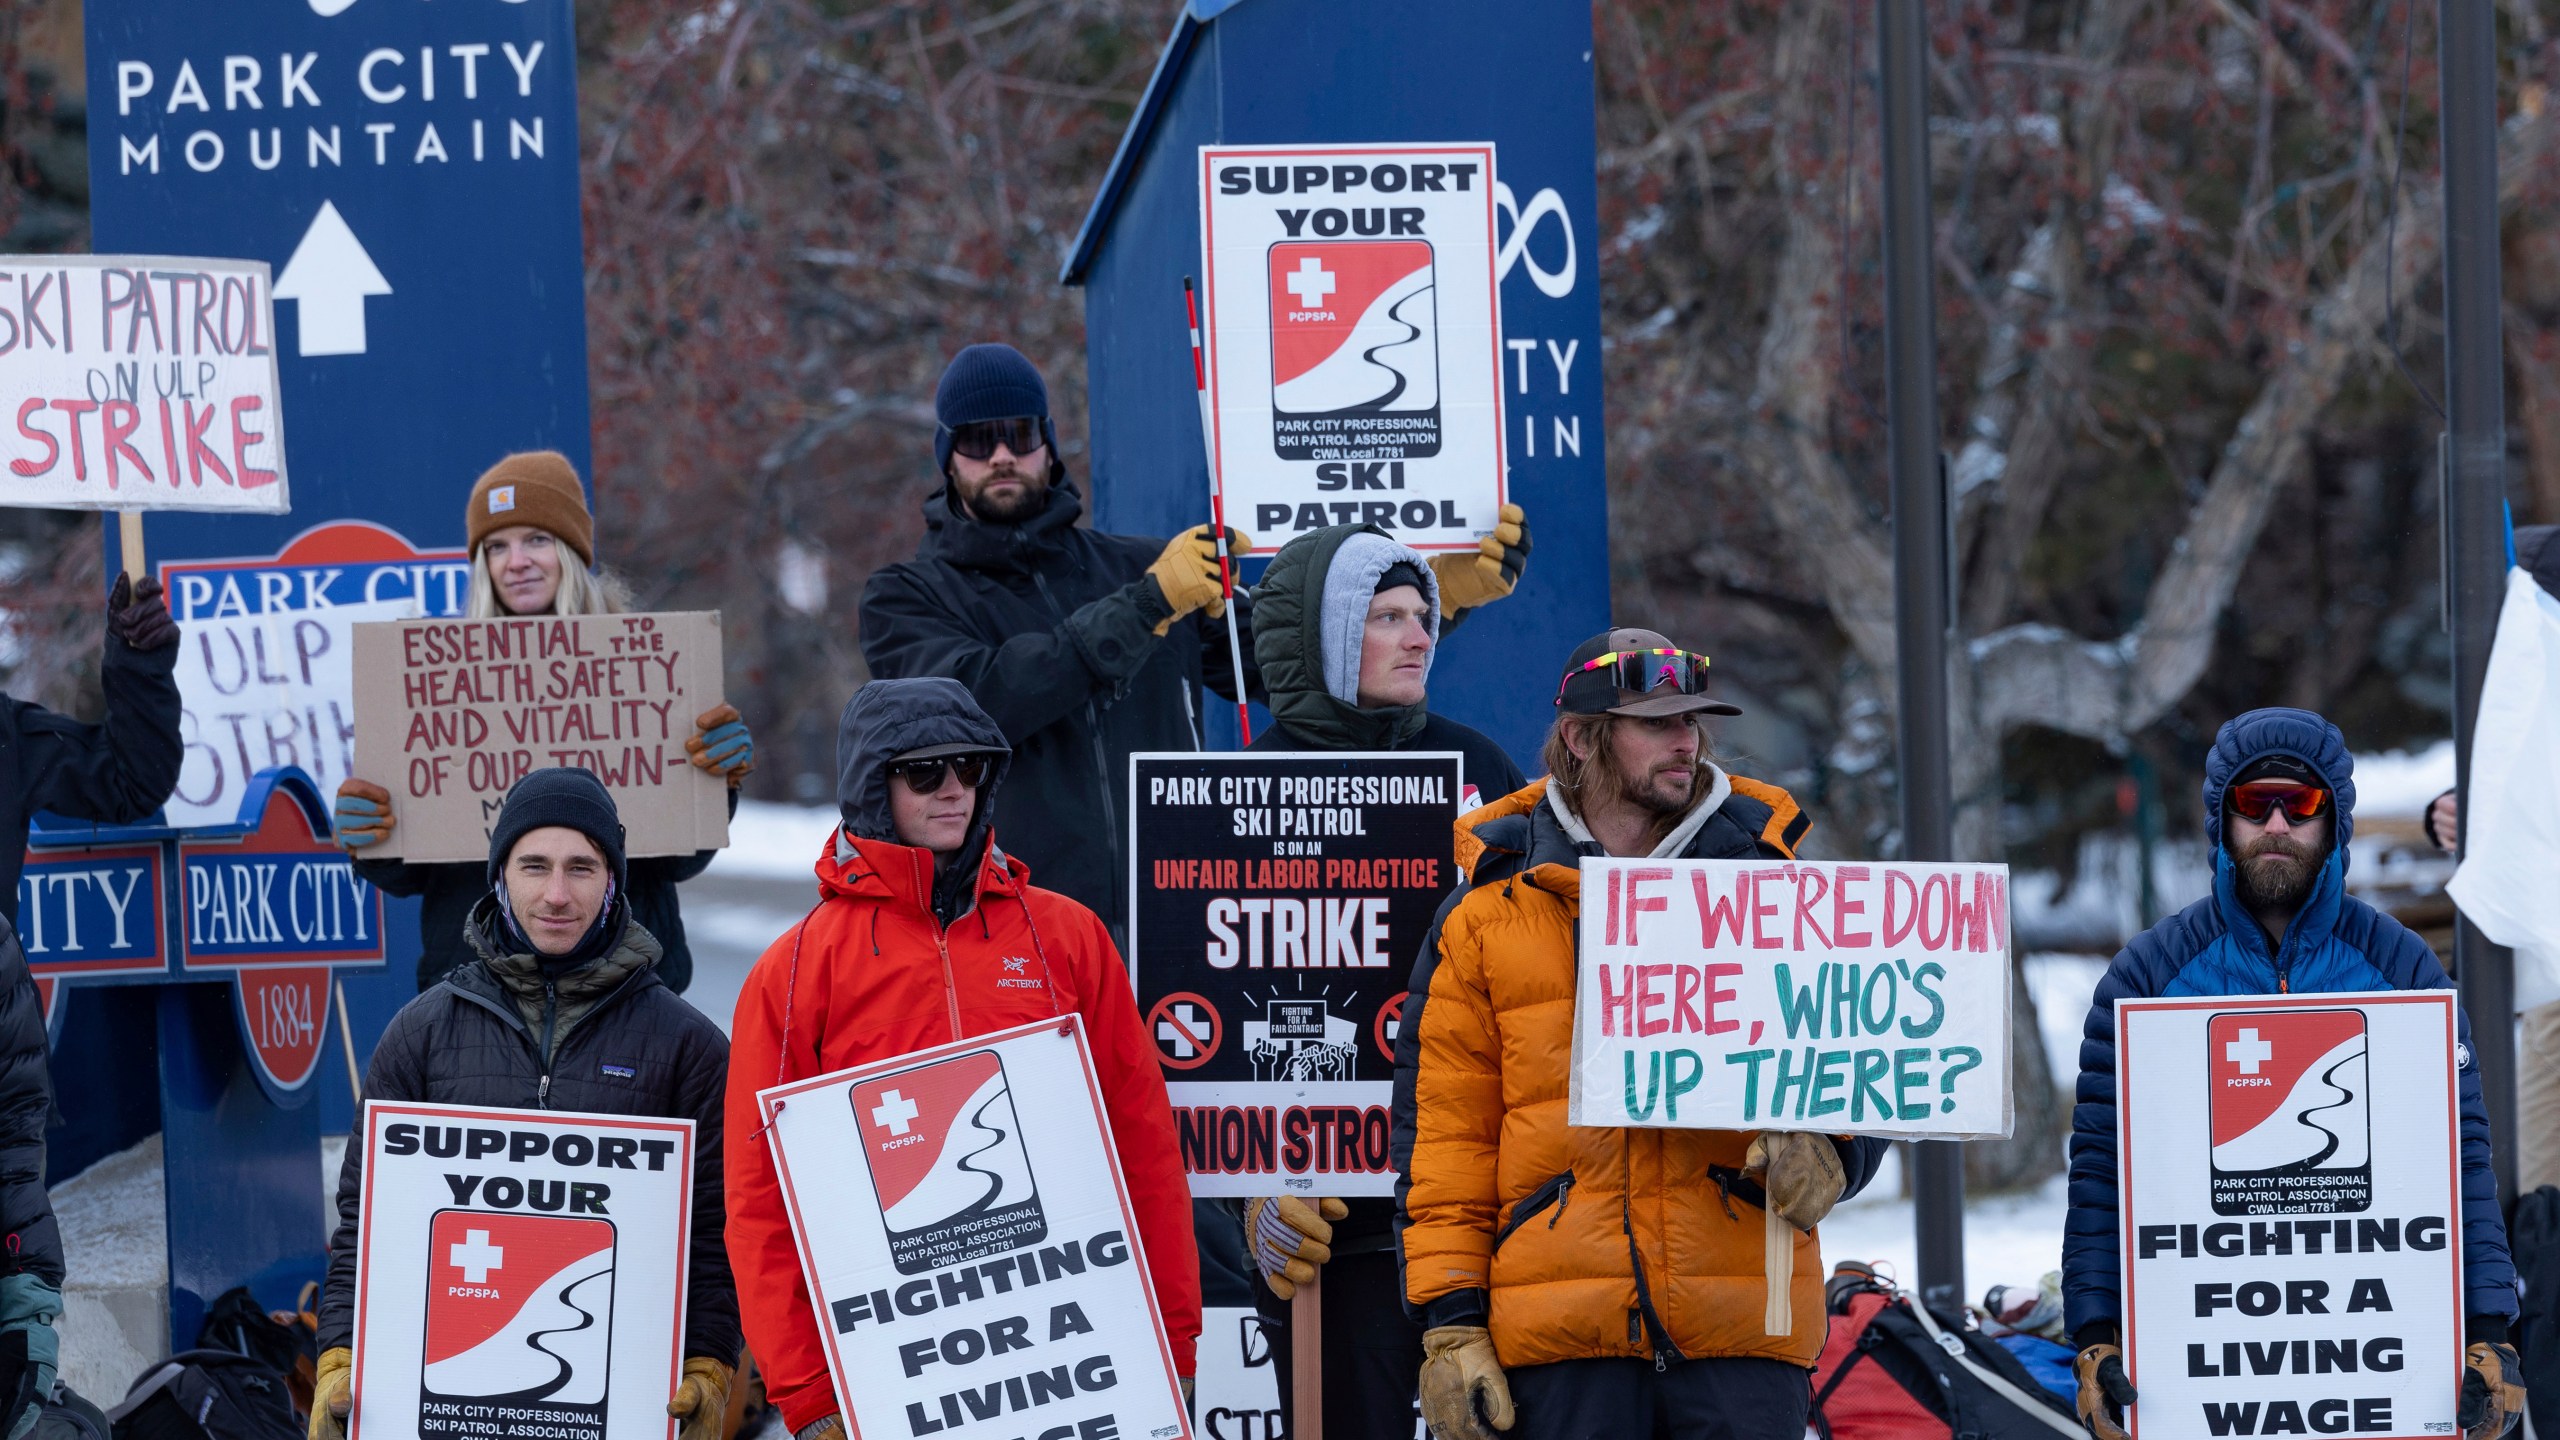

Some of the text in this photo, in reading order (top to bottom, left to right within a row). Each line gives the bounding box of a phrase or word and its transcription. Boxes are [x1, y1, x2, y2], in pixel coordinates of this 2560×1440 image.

[118, 40, 544, 116] PARK CITY
[120, 117, 544, 175] MOUNTAIN
[1220, 163, 1478, 194] SUPPORT
[1275, 207, 1425, 236] YOUR
[0, 268, 268, 357] SKI PATROL
[1288, 311, 1336, 322] PCPSPA
[87, 360, 215, 405] ON ULP
[1507, 339, 1578, 394] TY
[10, 396, 279, 490] STRIKE
[1276, 418, 1437, 431] PARK CITY PROFESSIONAL
[1278, 433, 1436, 446] SKI PATROL ASSOCIATION
[1312, 447, 1404, 459] CWA Local 7781
[1315, 461, 1405, 491] SKI
[1256, 500, 1466, 531] PATROL
[176, 563, 471, 621] PARK CIT
[199, 620, 331, 695] ULP
[404, 618, 664, 666] ESSENTIAL TO THE
[404, 652, 684, 708] HEALTH, SAFETY,
[405, 700, 673, 752] AND VITALITY
[409, 755, 452, 798] OF
[468, 750, 532, 792] OUR
[1151, 776, 1448, 805] PARK CITY PROFESSIONAL
[1233, 808, 1366, 836] SKI PATROL
[1273, 842, 1321, 856] IS ON AN
[1154, 858, 1438, 889] UNFAIR LABOR PRACTICE
[18, 868, 144, 953] ITY
[189, 862, 368, 944] PARK CITY
[1605, 863, 2004, 953] IF WE'RE DOWN
[1206, 897, 1390, 969] STRIKE
[259, 983, 314, 1048] 1884
[1281, 1006, 1312, 1016] FIGHTING
[1287, 1016, 1307, 1024] FOR A
[1599, 958, 1946, 1045] HERE, WHO'S
[1271, 1024, 1323, 1033] FAIR CONTRACT
[1624, 1046, 1982, 1122] UP THERE?
[2227, 1077, 2272, 1088] PCPSPA
[384, 1123, 675, 1171] SUPPORT
[881, 1133, 925, 1152] PCPSPA
[1172, 1104, 1393, 1175] NION STRO
[443, 1173, 611, 1215] YOUR
[2214, 1176, 2368, 1189] PARK CITY PROFESSIONAL
[2215, 1189, 2366, 1203] SKI PATROL ASSOCIATION
[892, 1207, 1040, 1251] PARK CITY PROFESSIONAL
[2248, 1203, 2336, 1214] CWA Local 7781
[897, 1220, 1041, 1264] SKI PATROL ASSOCIATION
[931, 1239, 1015, 1268] CWA Local 7781
[2139, 1216, 2446, 1259] FIGHTING
[448, 1286, 500, 1300] PCPSPA
[831, 1230, 1129, 1335] FIGHTING
[2194, 1278, 2393, 1317] FOR A
[899, 1301, 1094, 1378] FOR A
[2187, 1337, 2403, 1377] LIVING
[423, 1403, 602, 1425] PARK CITY PROFESSIONAL
[905, 1354, 1117, 1438] LIVING
[2202, 1398, 2392, 1436] WAGE
[424, 1419, 446, 1431] SKI
[450, 1421, 504, 1435] PATROL
[507, 1424, 599, 1440] ASSOCIATION
